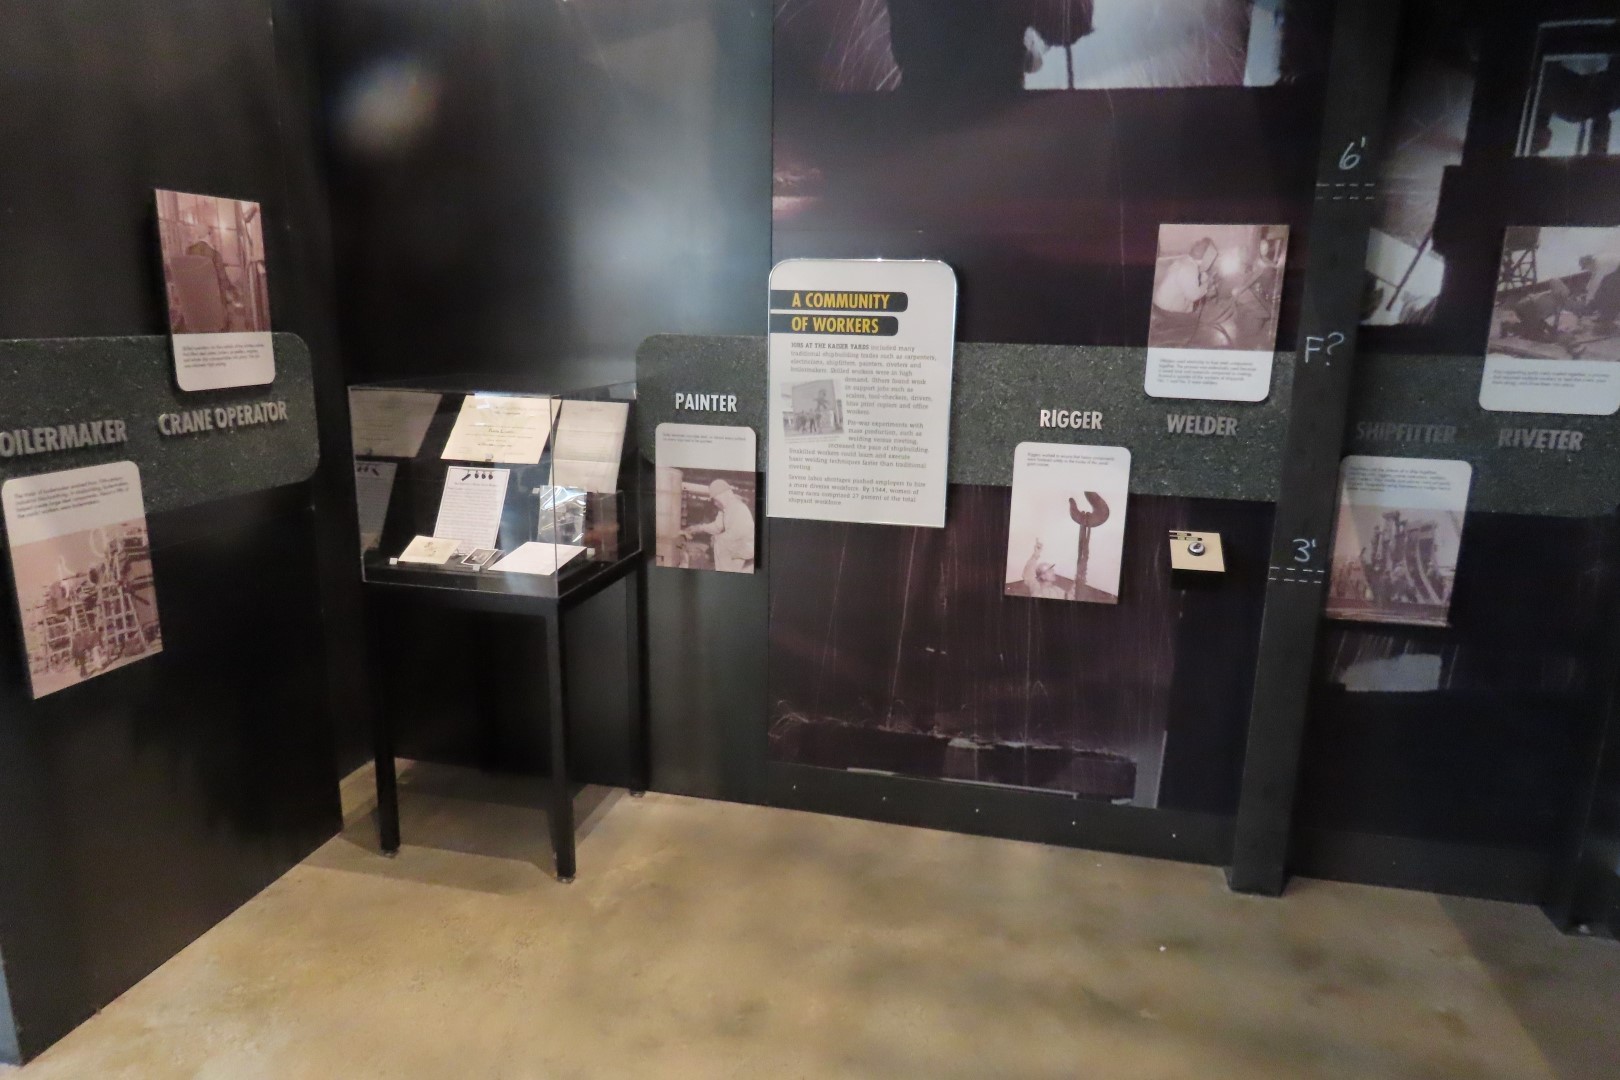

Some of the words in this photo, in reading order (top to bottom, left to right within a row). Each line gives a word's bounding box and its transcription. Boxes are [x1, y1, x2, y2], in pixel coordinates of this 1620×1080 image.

[1338, 136, 1366, 170] 6'
[792, 292, 801, 308] A
[806, 292, 890, 309] COMMUNITY
[792, 316, 808, 332] OF
[813, 317, 878, 334] WORKERS
[1304, 331, 1344, 366] F?
[675, 392, 738, 412] PAINTER
[158, 409, 213, 436] CRANE
[214, 401, 288, 428] OPERATOR
[1040, 409, 1103, 430] RIGGER
[1166, 414, 1238, 436] WELDER
[1356, 421, 1458, 444] SHIPFITTER
[1498, 428, 1584, 450] RIVETER
[1292, 538, 1316, 562] 3'
